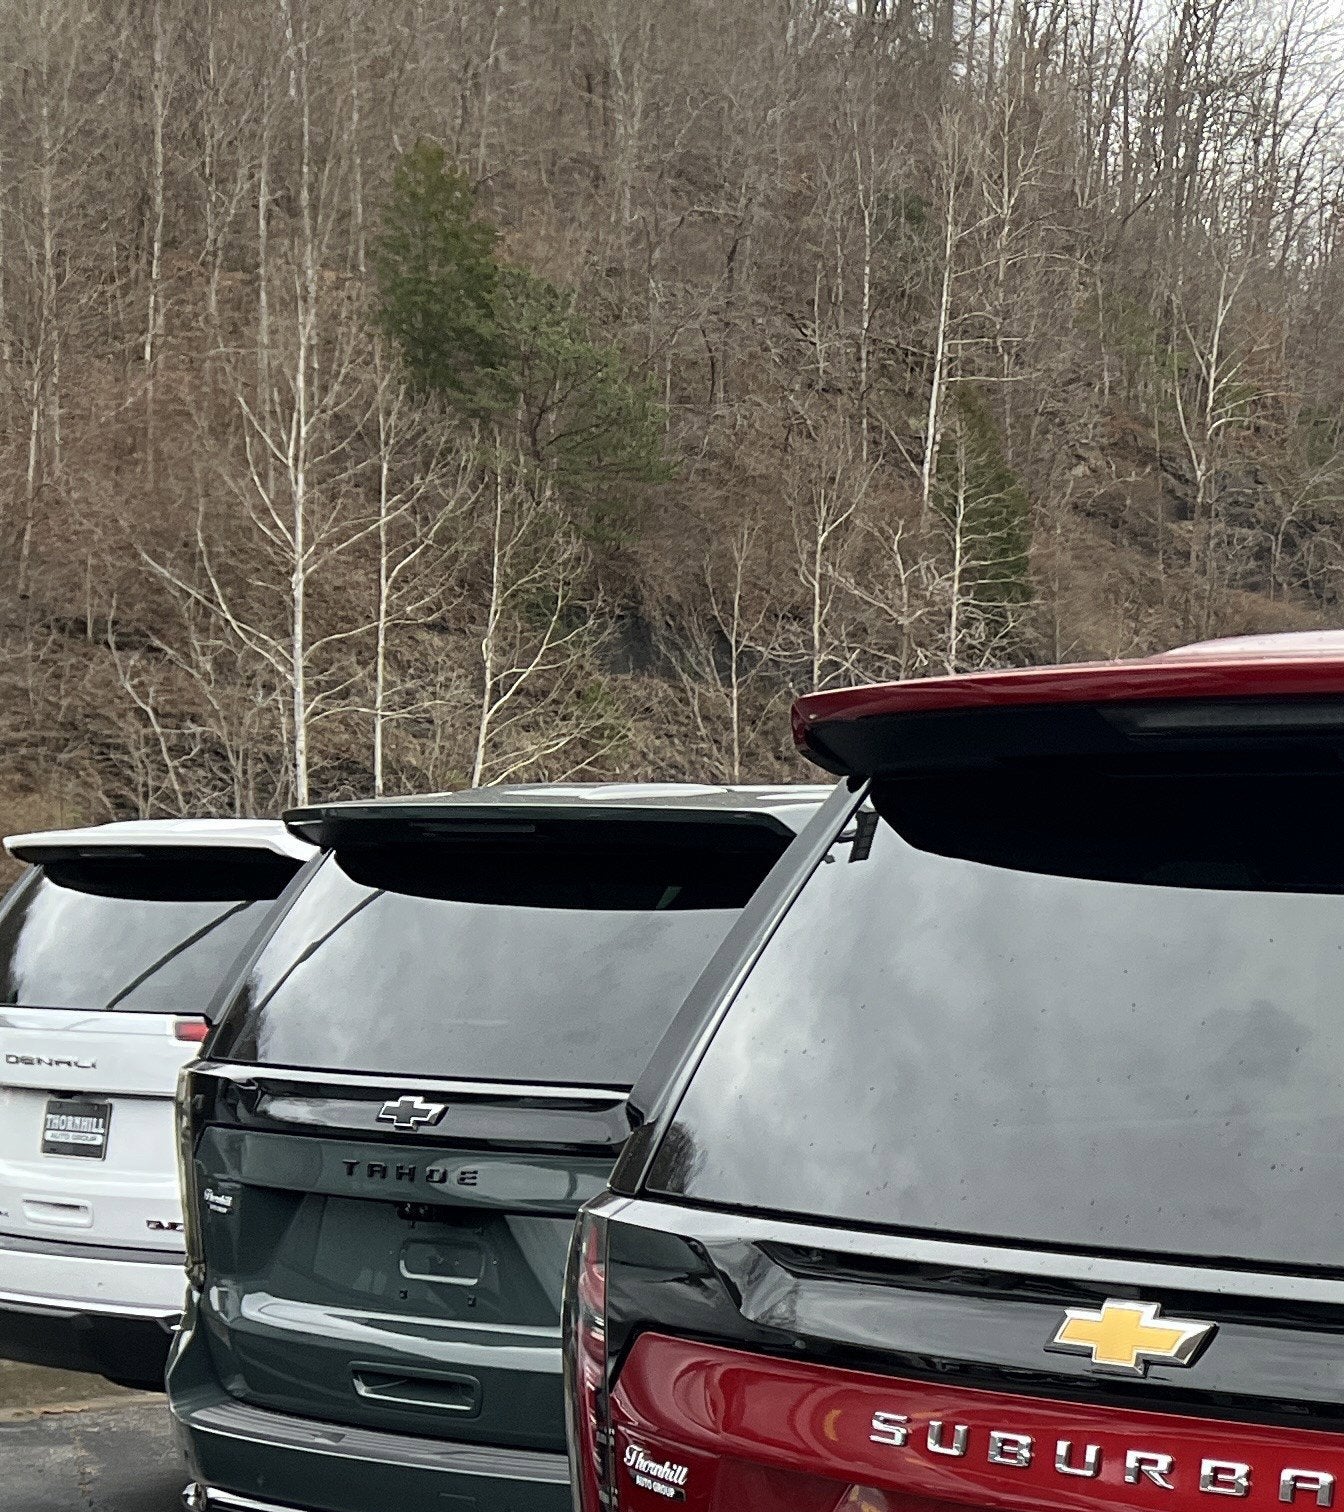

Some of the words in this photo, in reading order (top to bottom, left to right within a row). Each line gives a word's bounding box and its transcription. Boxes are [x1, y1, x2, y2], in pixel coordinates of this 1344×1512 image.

[5, 1054, 97, 1069] DENALI
[46, 1114, 104, 1133] THORNHILL
[342, 1159, 479, 1186] TAHOE
[623, 1444, 688, 1486] Thornhill
